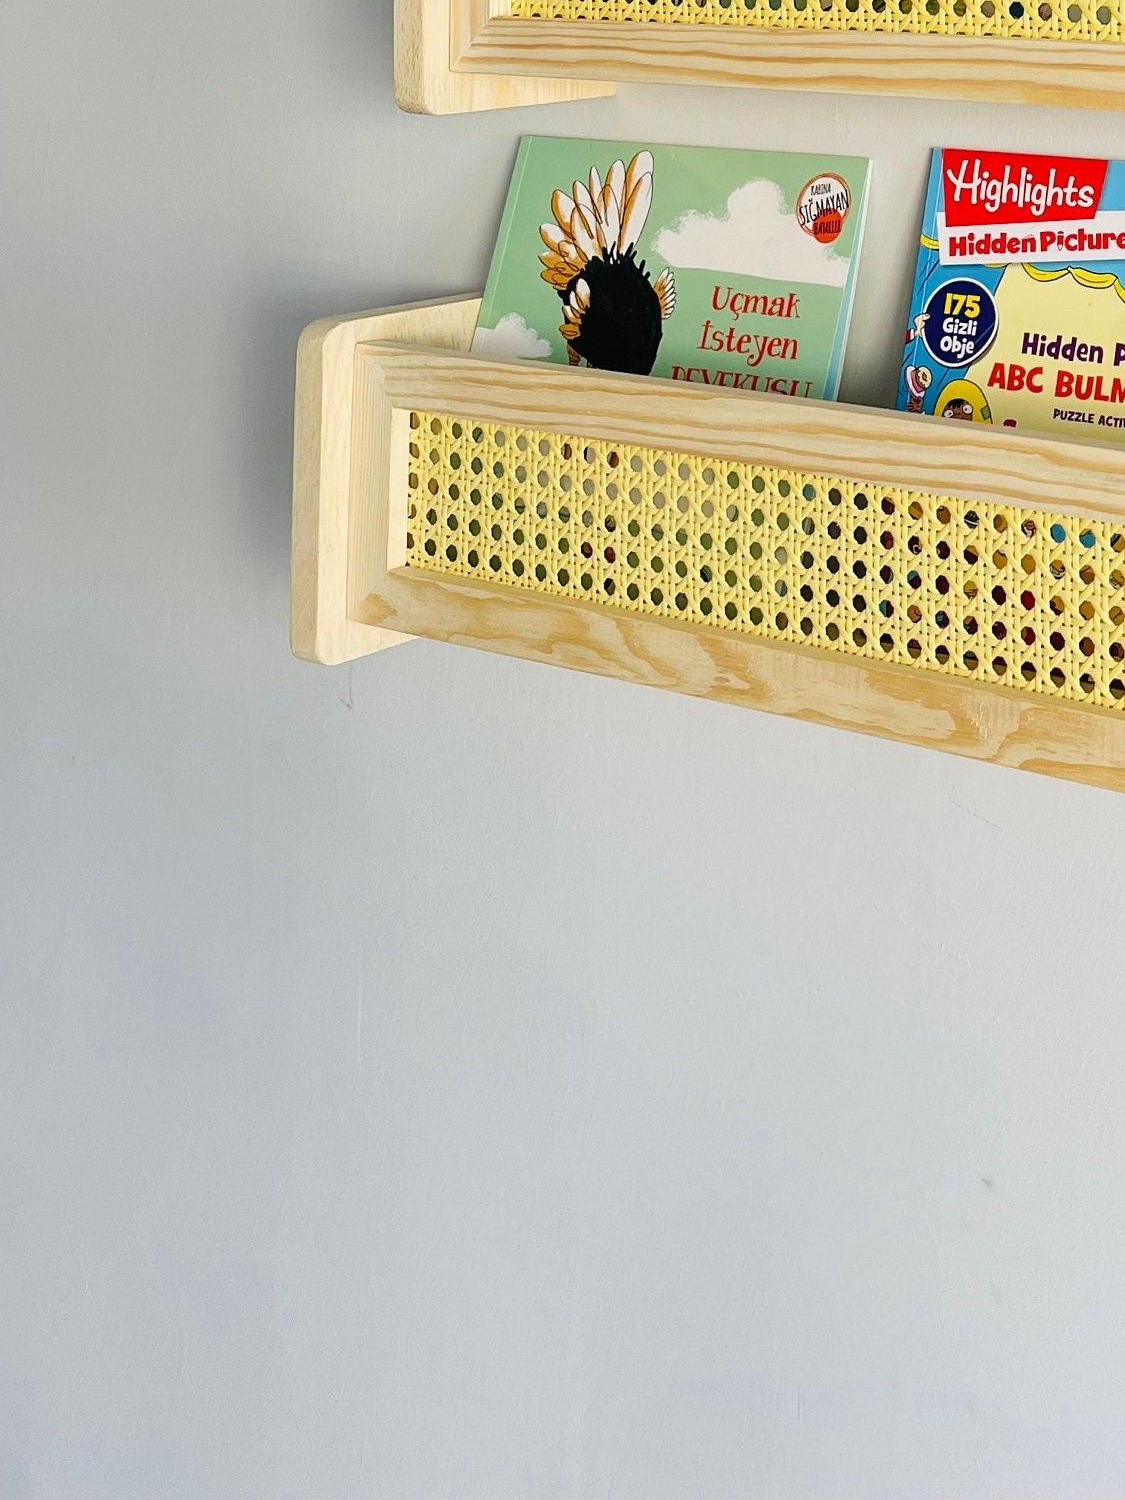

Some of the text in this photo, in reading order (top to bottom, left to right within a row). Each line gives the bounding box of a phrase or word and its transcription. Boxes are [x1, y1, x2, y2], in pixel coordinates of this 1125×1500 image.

[946, 158, 1095, 216] Highlights
[949, 231, 1036, 257] Hidden
[711, 285, 800, 321] Uçmak
[943, 292, 981, 317] 175
[942, 317, 978, 337] Gizli
[697, 319, 799, 367] İsteyen
[939, 335, 975, 360] Obje
[1021, 332, 1103, 364] Hidden
[987, 362, 1044, 394] ABC
[1053, 408, 1095, 425] PUZZLE
